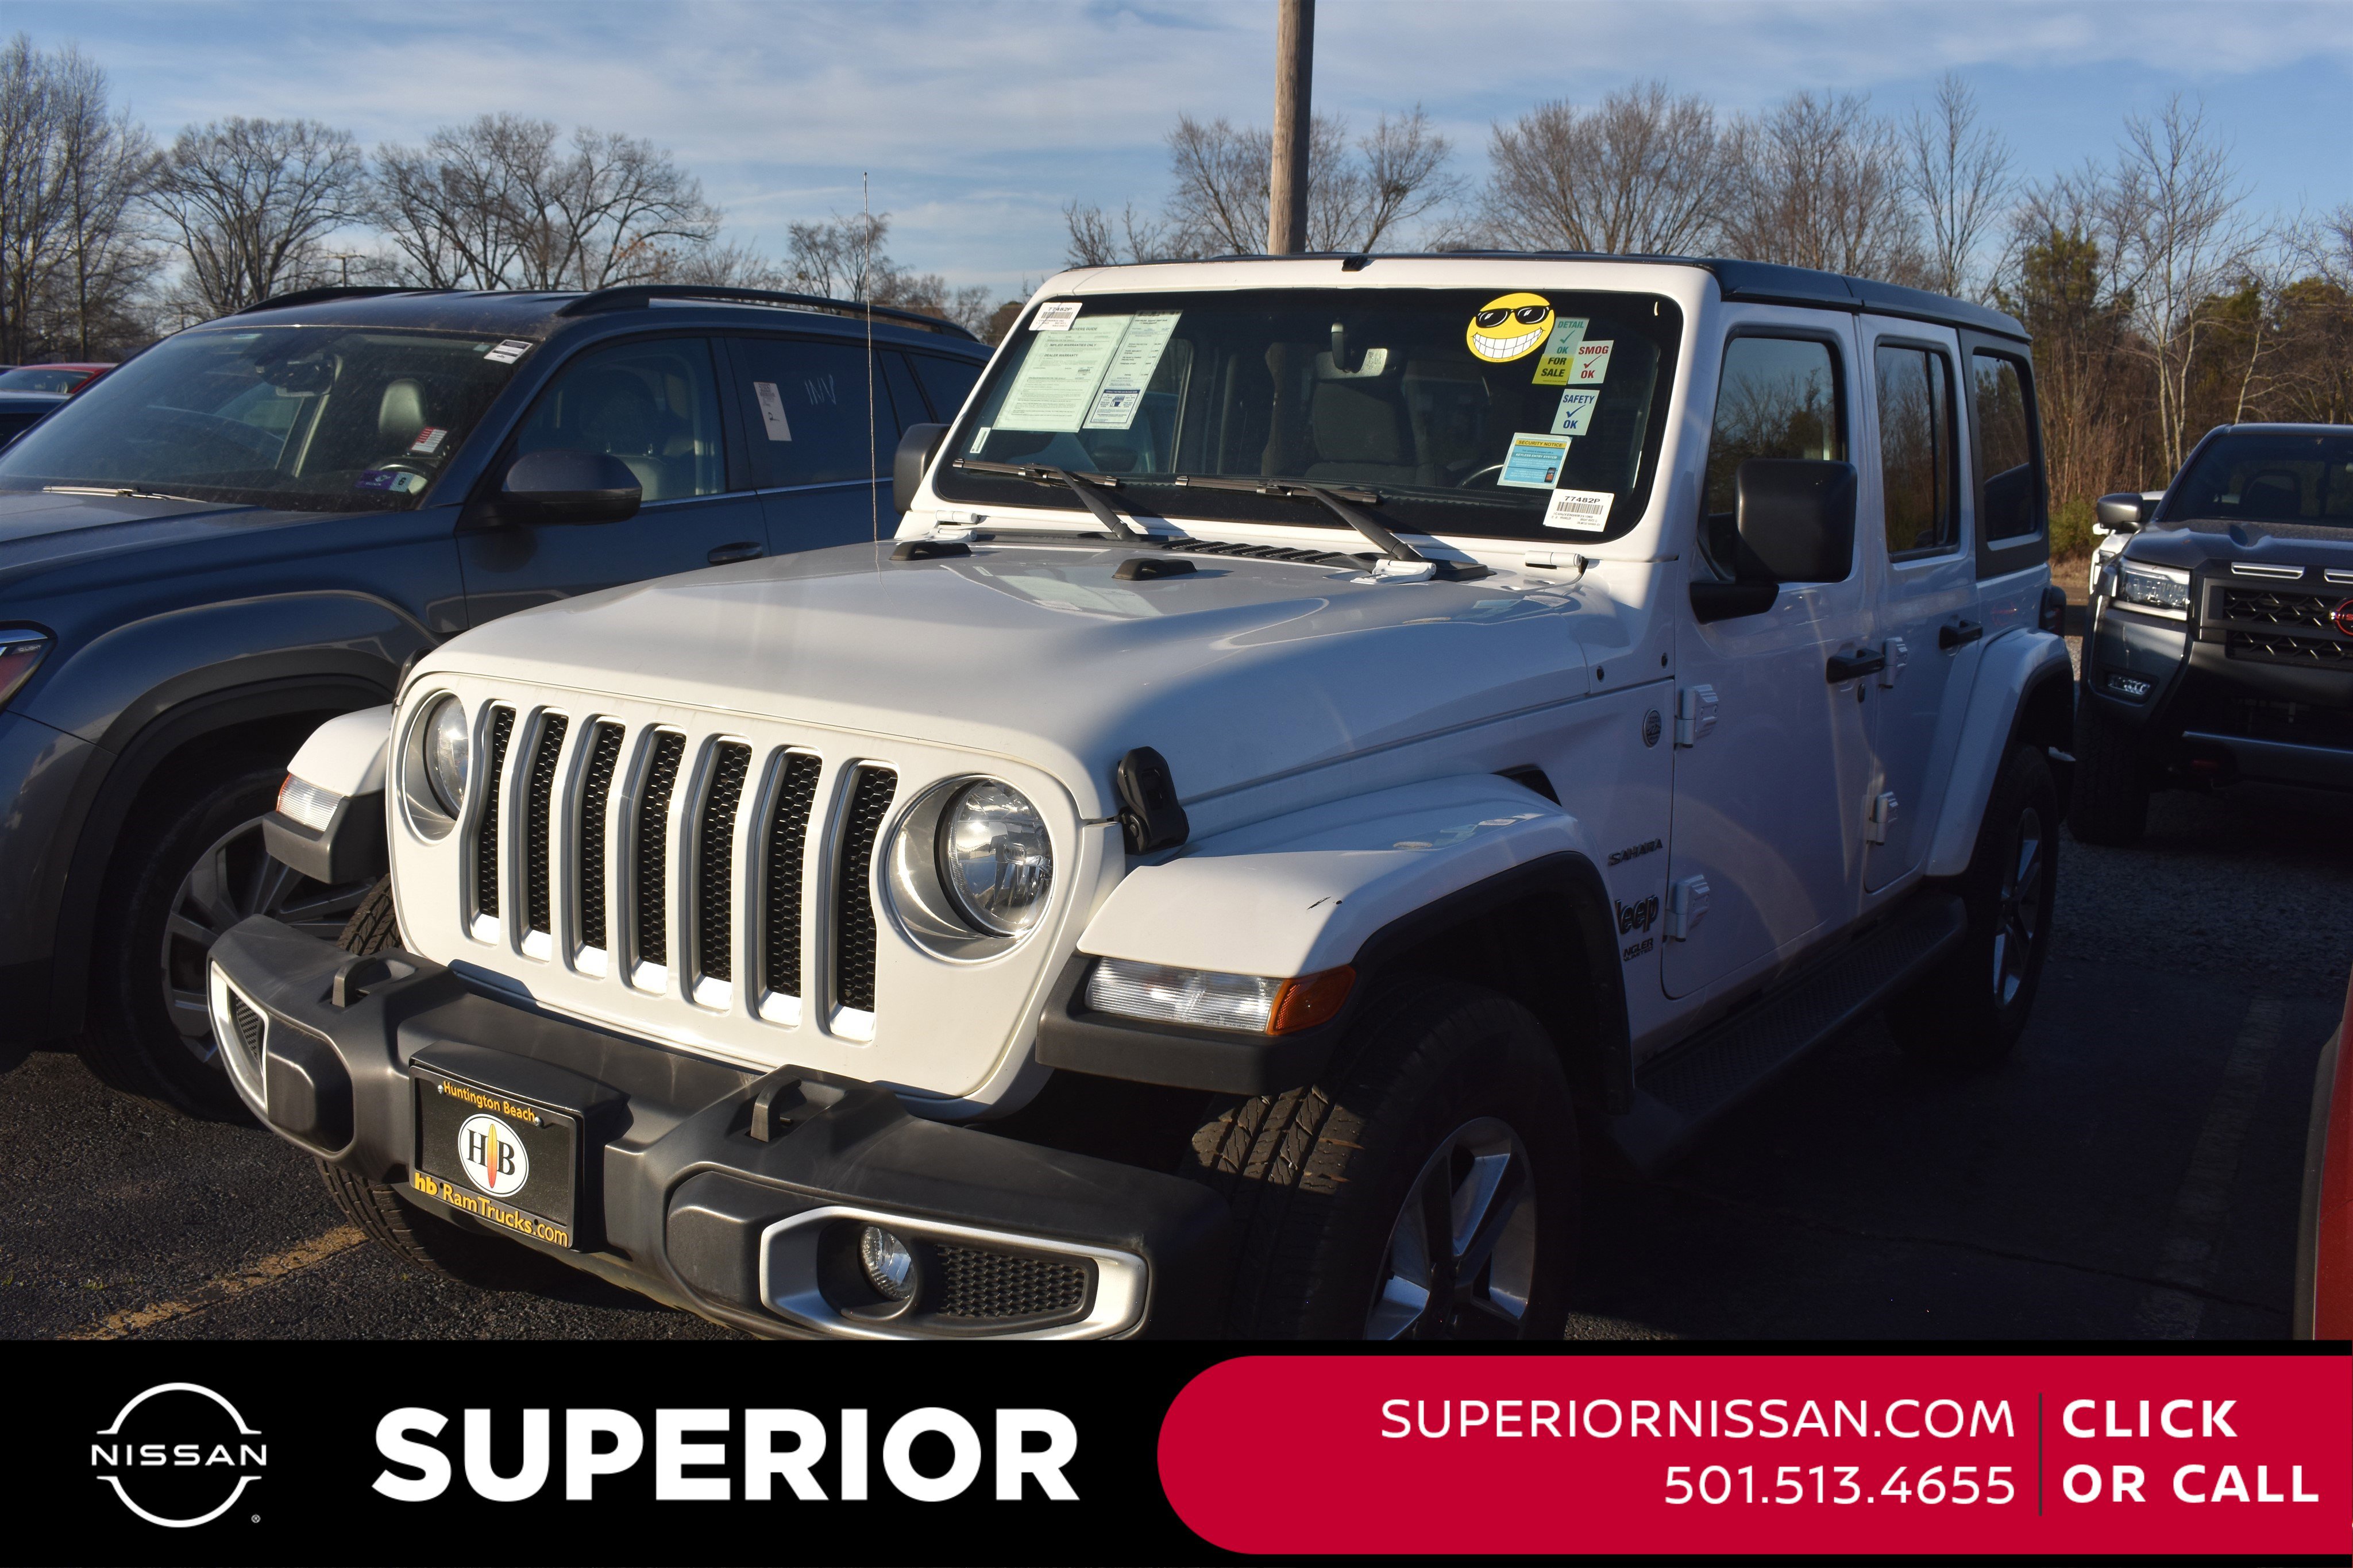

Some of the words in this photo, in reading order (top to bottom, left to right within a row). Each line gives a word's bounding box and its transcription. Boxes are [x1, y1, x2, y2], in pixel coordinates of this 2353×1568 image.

[1578, 346, 1609, 355] SMOG
[1541, 368, 1565, 377] SALE
[1580, 370, 1596, 379] OK
[1563, 395, 1595, 404] SAFETY
[1563, 420, 1579, 429] OK
[1564, 496, 1600, 504] 77482P
[1608, 838, 1663, 866] SAHARA
[1614, 894, 1659, 934] Jeep
[1623, 937, 1653, 957] NGLER
[443, 1081, 501, 1111] Huntington
[503, 1101, 536, 1122] Beach
[415, 1172, 438, 1196] hb
